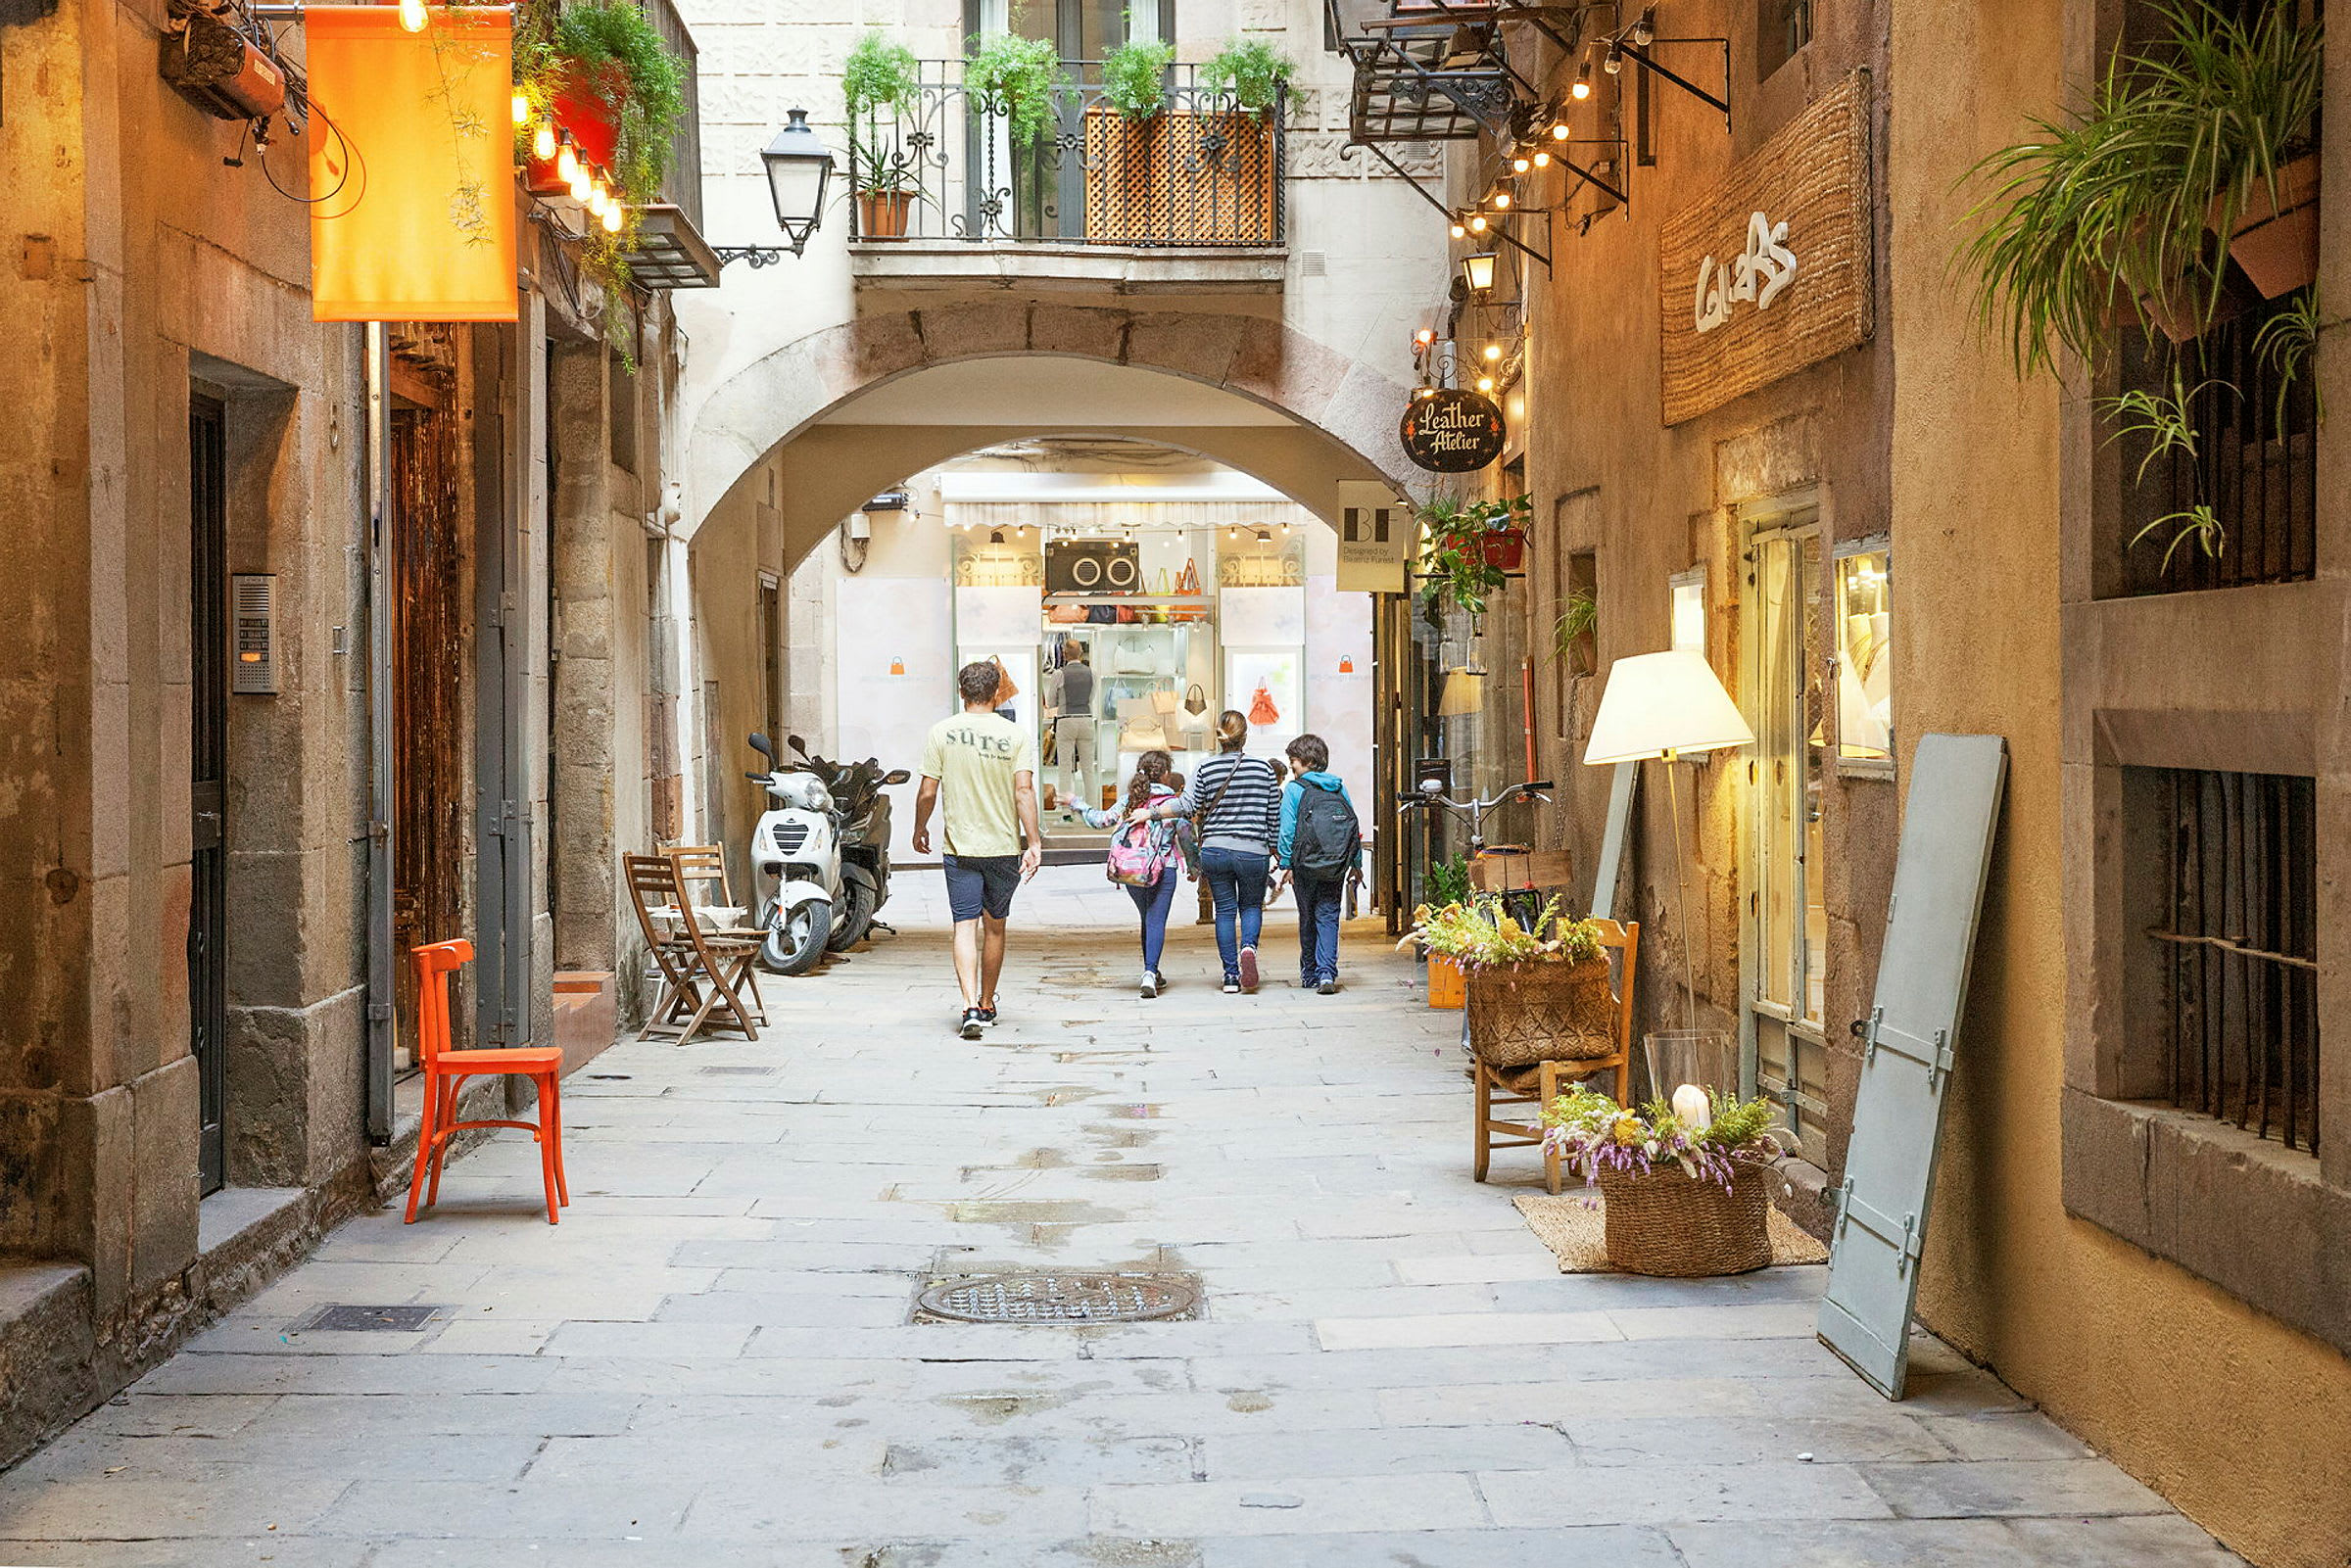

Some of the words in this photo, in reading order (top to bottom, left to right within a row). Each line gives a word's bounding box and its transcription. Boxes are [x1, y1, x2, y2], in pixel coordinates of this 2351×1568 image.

[1418, 401, 1485, 435] Leather
[1430, 430, 1481, 455] Atelier
[1343, 507, 1399, 543] BF
[1343, 546, 1378, 556] Designed
[1379, 547, 1389, 556] by
